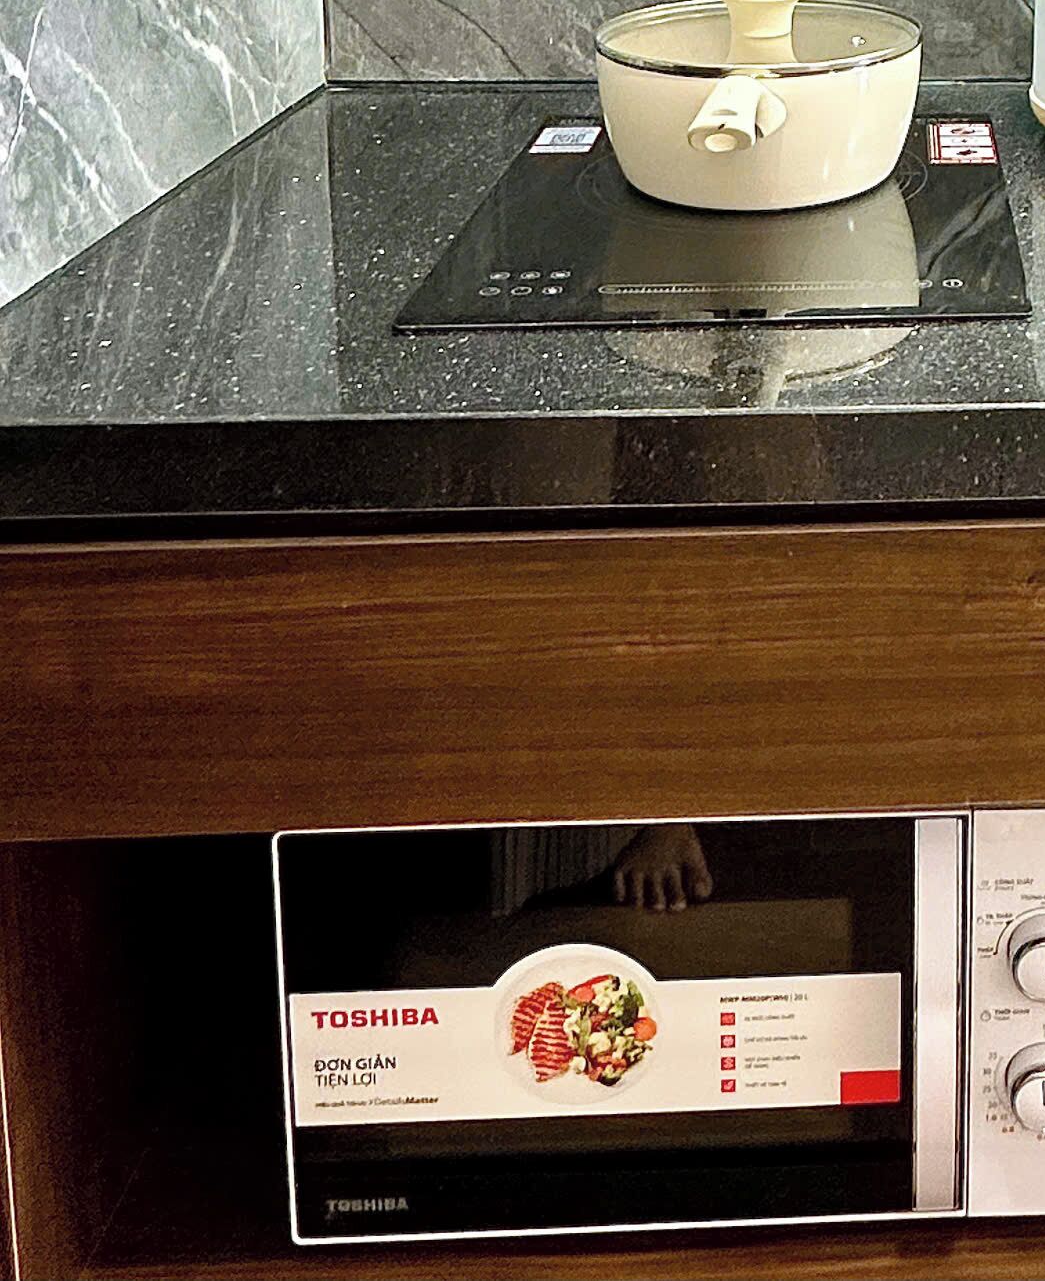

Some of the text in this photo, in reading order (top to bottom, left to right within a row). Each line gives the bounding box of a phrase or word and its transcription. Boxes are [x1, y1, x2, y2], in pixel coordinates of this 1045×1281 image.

[311, 1007, 440, 1029] TOSHIBA
[314, 1053, 397, 1072] ĐƠN GIẢN
[315, 1072, 377, 1089] TIỆN LỢI
[324, 1197, 409, 1212] TOSHIBA
